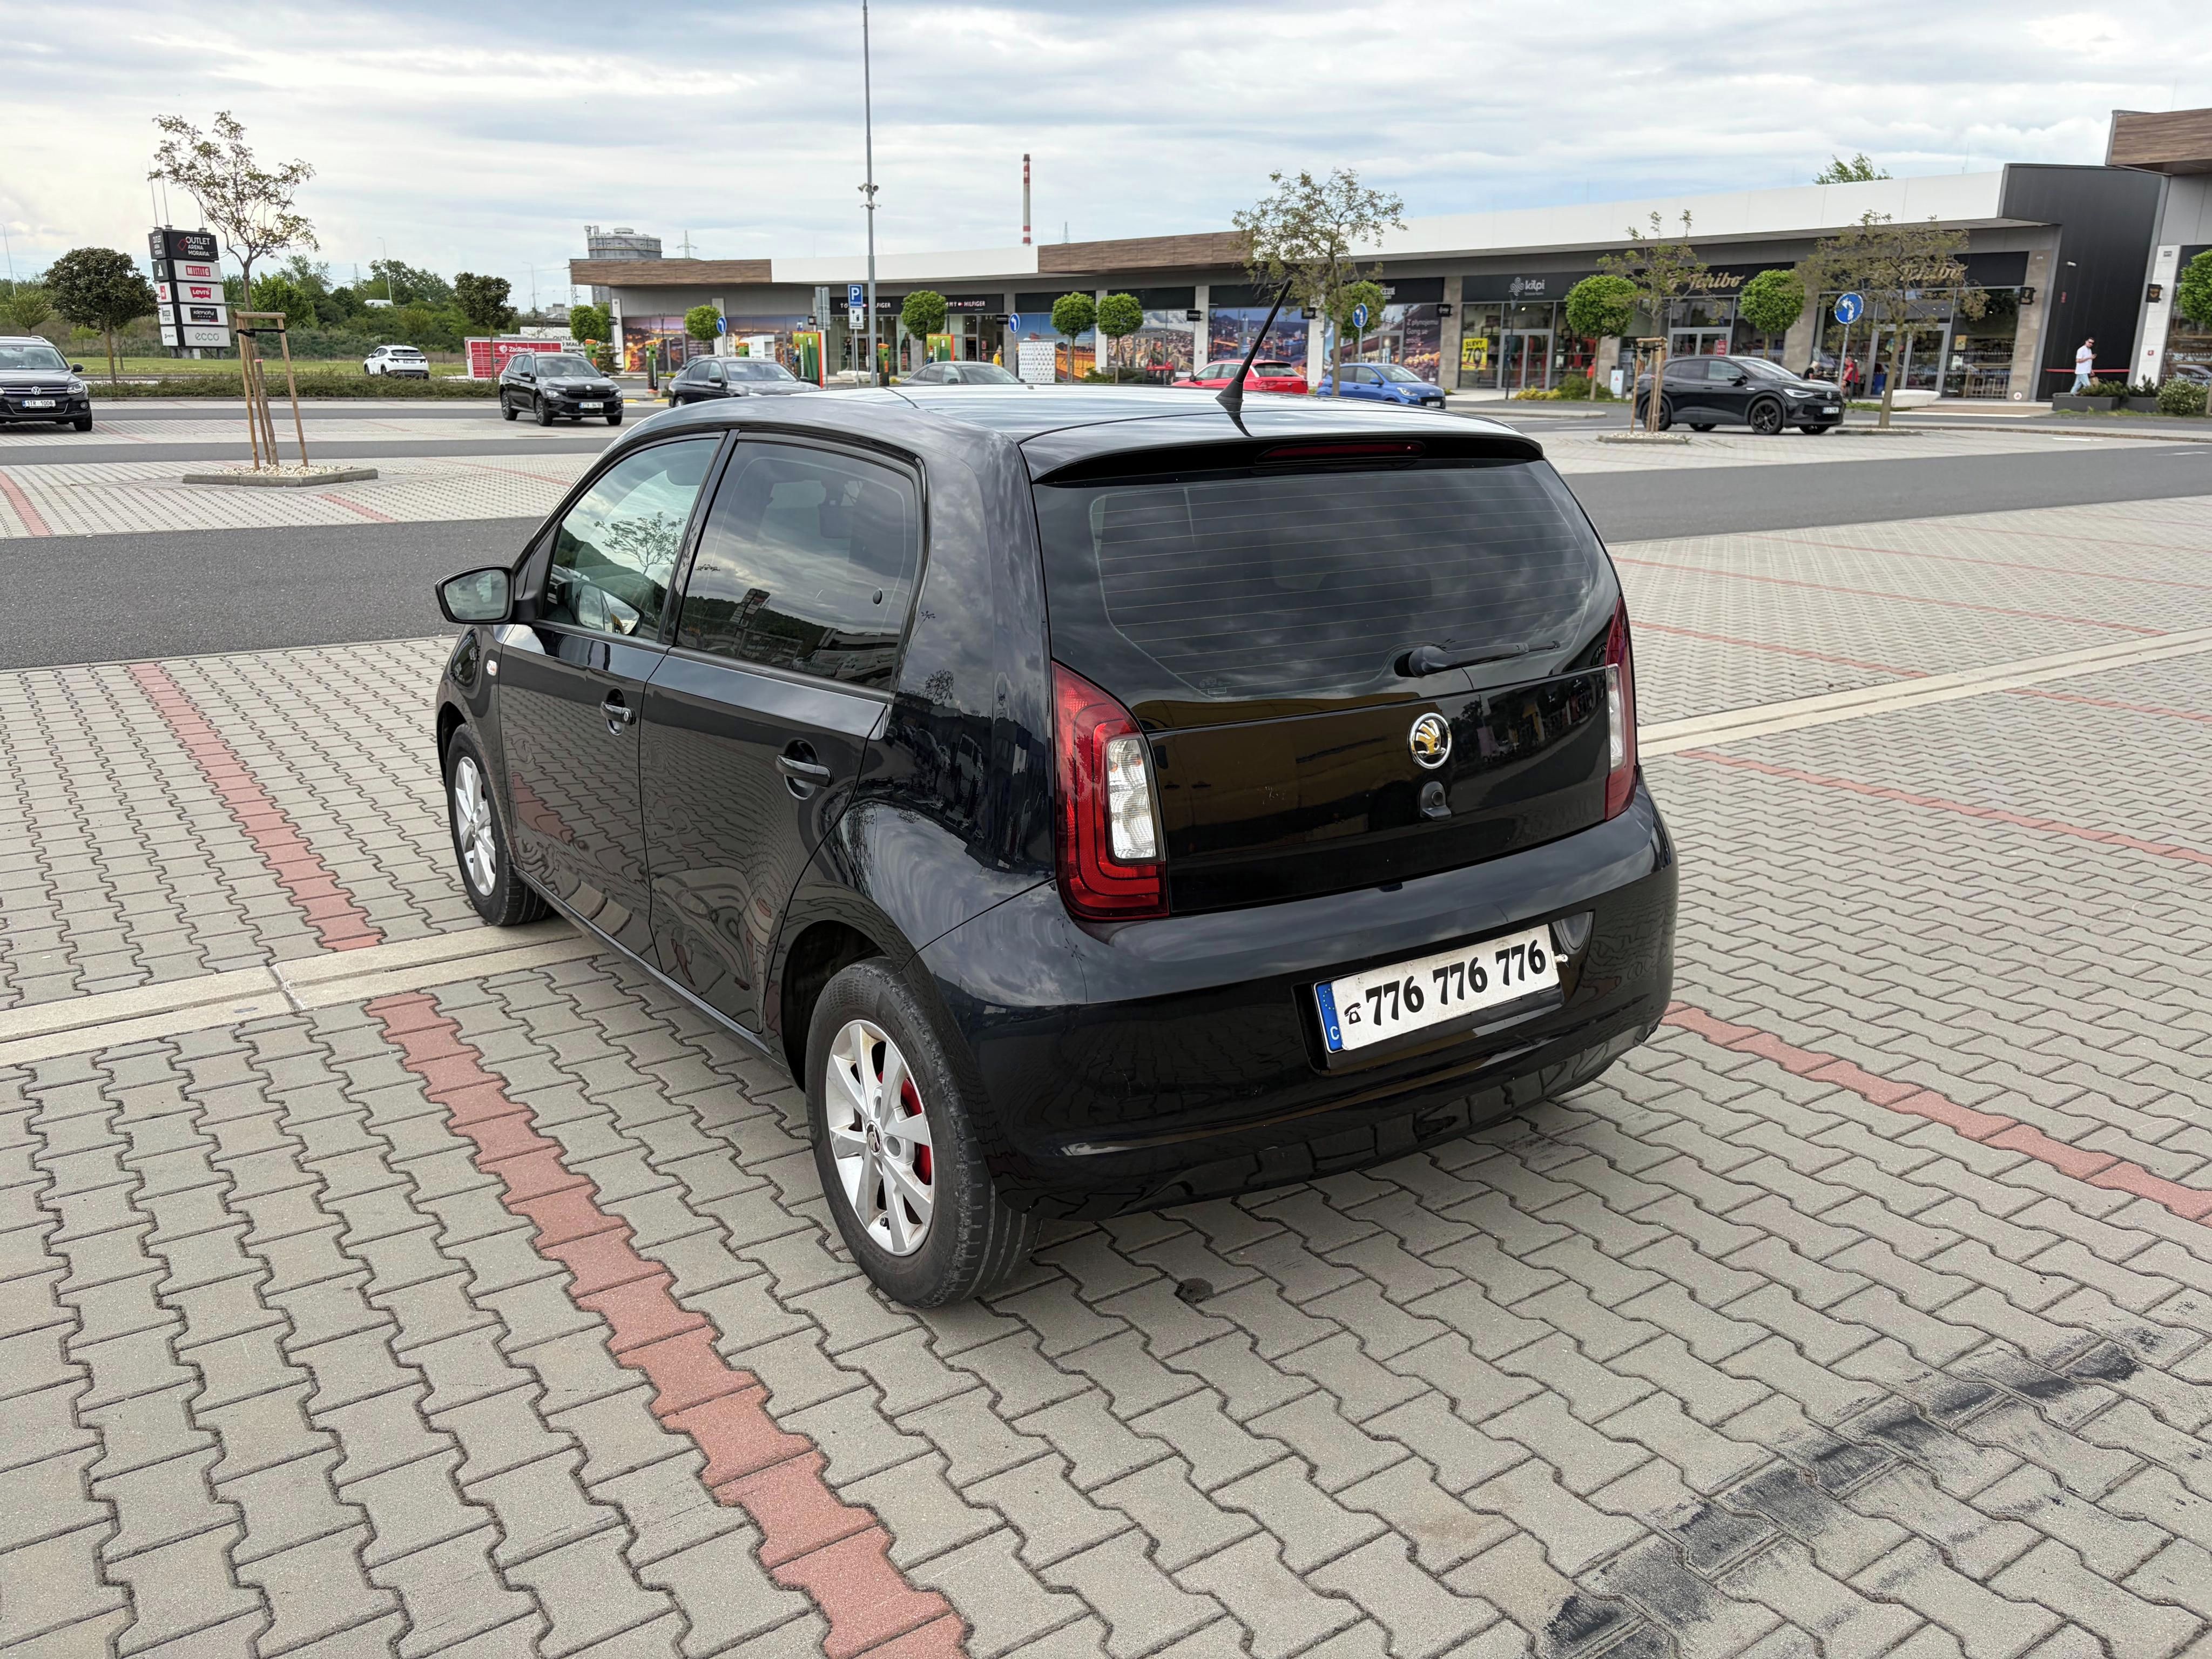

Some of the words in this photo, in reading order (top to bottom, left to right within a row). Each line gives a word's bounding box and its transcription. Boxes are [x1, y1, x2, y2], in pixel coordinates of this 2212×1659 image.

[185, 236, 210, 245] OUTLET
[1525, 279, 1545, 292] kilpi
[851, 287, 860, 301] P
[195, 332, 219, 341] ecco
[1365, 975, 1424, 1026] 776
[1433, 957, 1488, 1005] 776
[1495, 940, 1546, 986] 776
[1330, 1026, 1340, 1041] C
